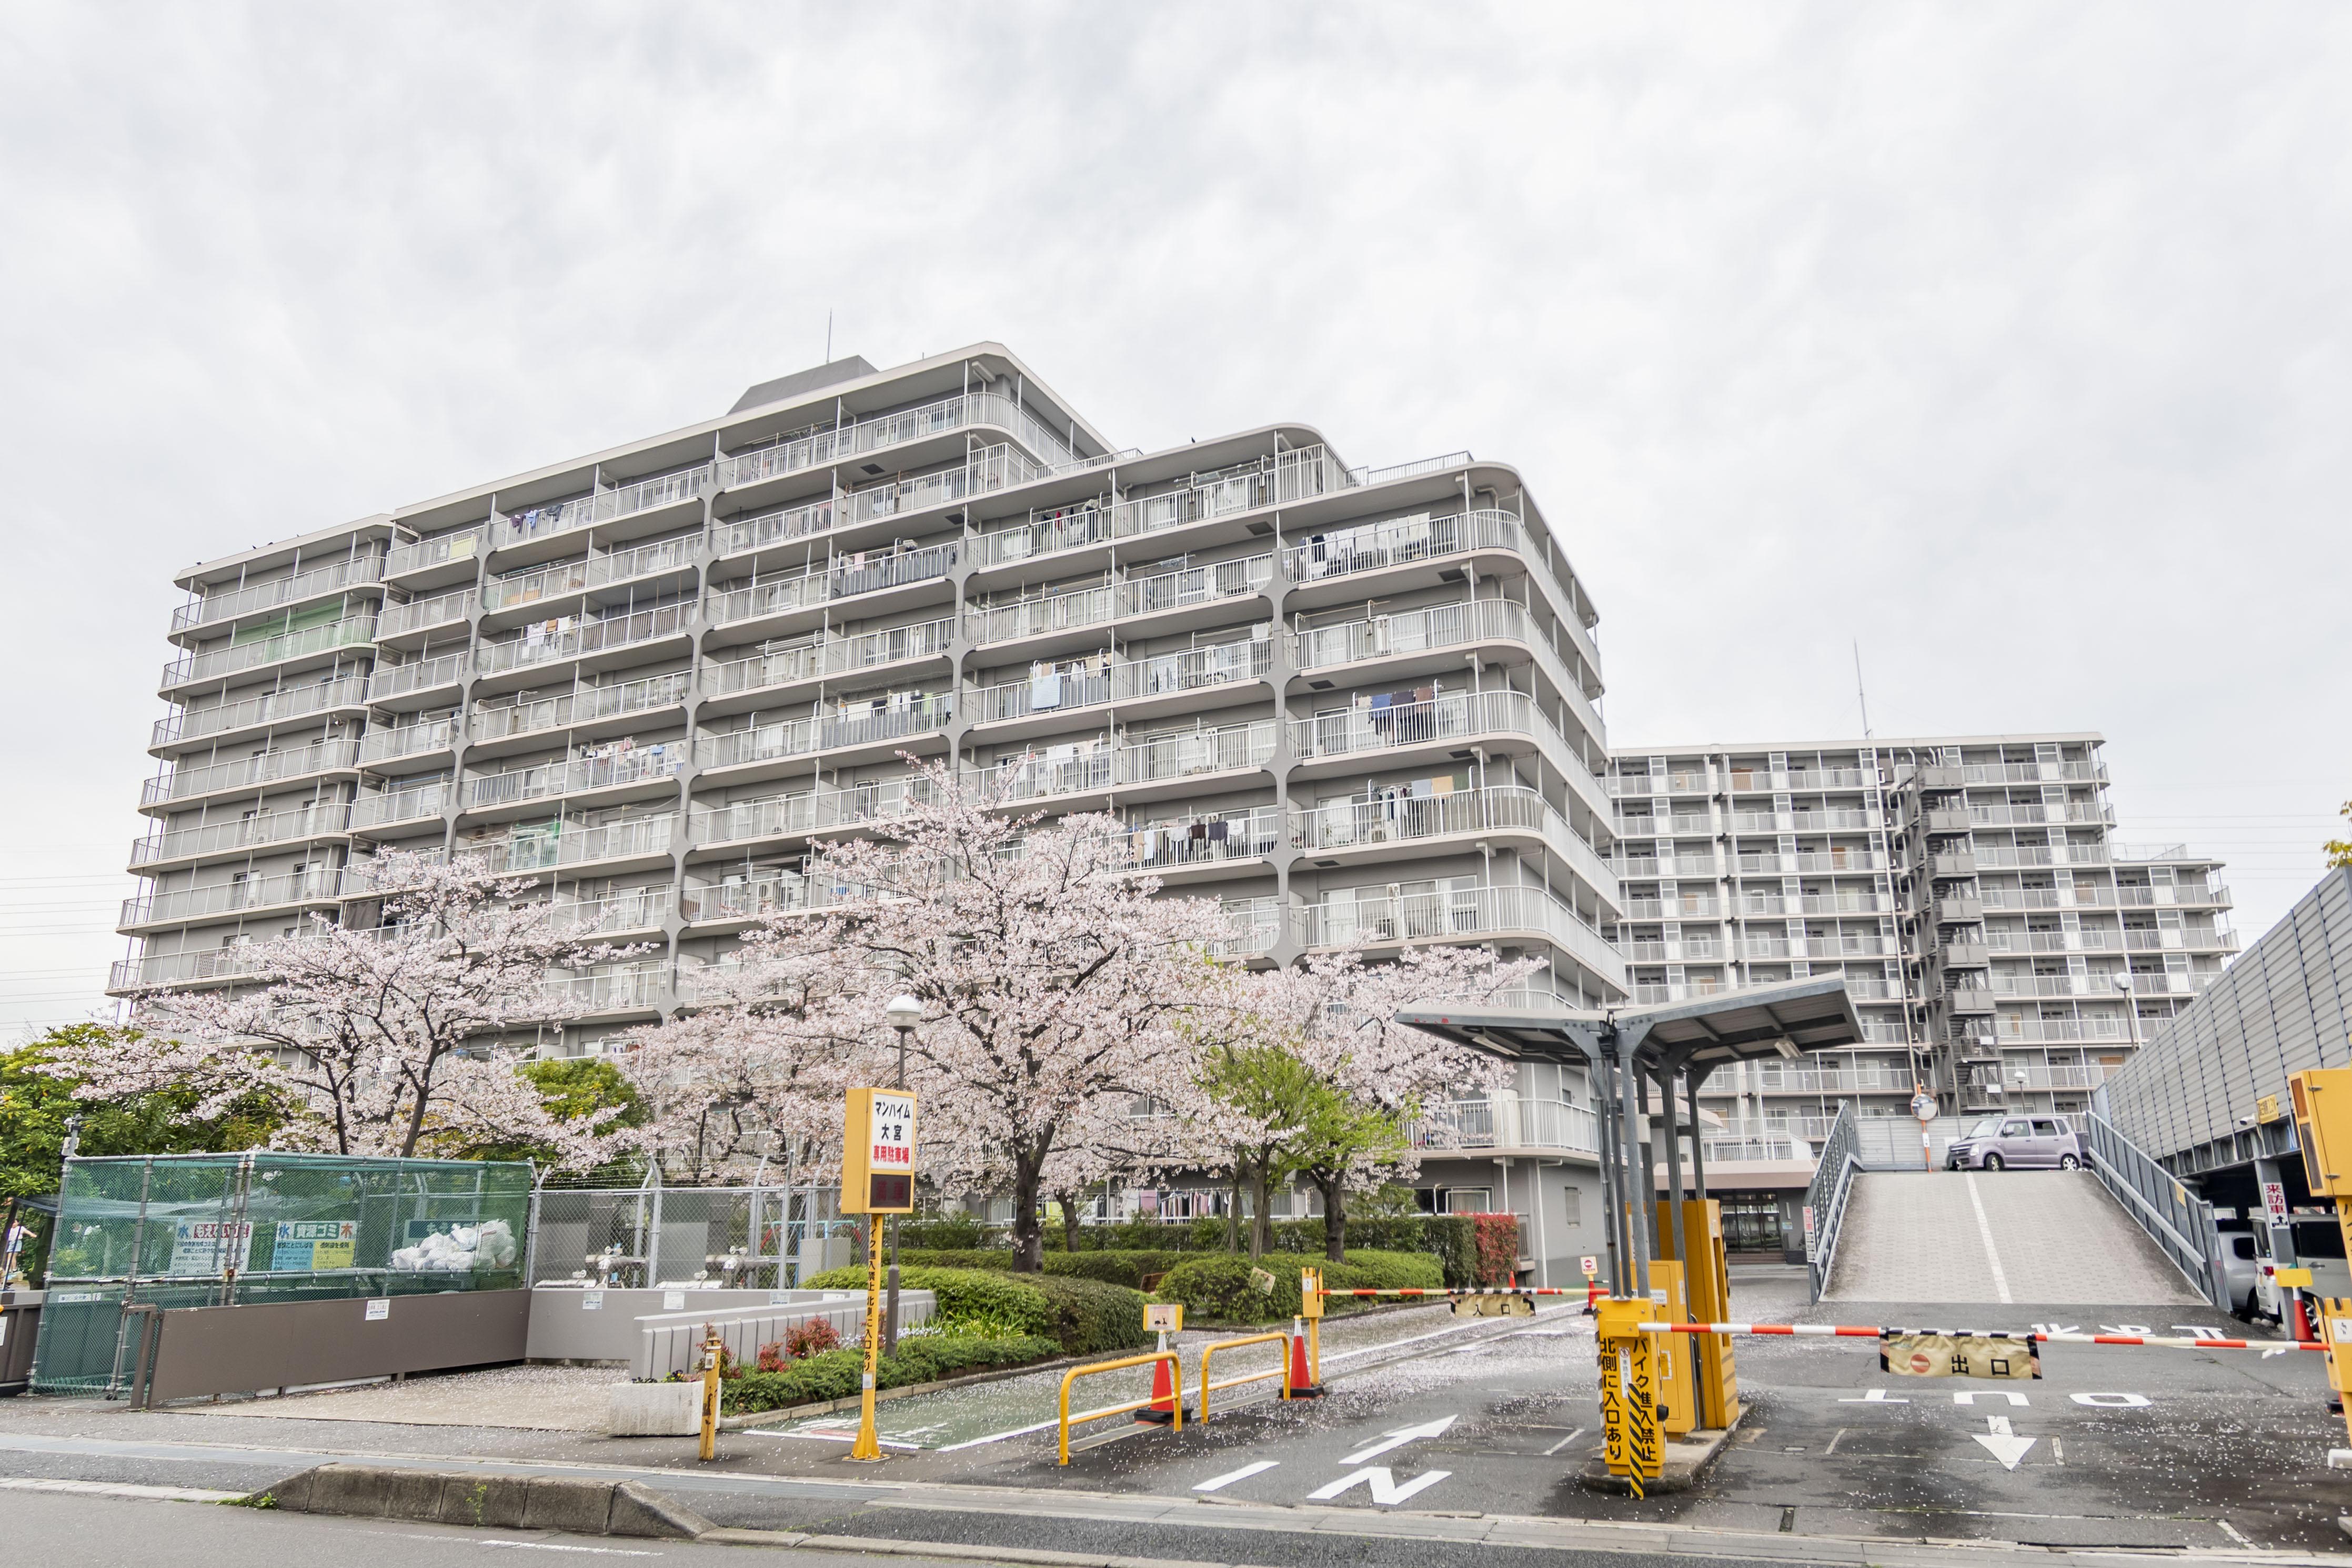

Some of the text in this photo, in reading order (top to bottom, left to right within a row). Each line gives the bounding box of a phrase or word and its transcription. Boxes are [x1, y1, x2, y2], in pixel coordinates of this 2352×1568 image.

[876, 1101, 910, 1120] マンハイム
[881, 1123, 902, 1141] 大宮
[873, 1145, 909, 1164] 専用駐車場
[2266, 1184, 2286, 1214] 来訪車
[296, 1224, 337, 1238] 資源ゴミ
[340, 1223, 353, 1238] 木
[1472, 1304, 1511, 1316] 入口
[1951, 1354, 2011, 1376] 出口
[1600, 1338, 1622, 1461] 北側に入口あり
[1633, 1337, 1657, 1462] バイク進入禁止
